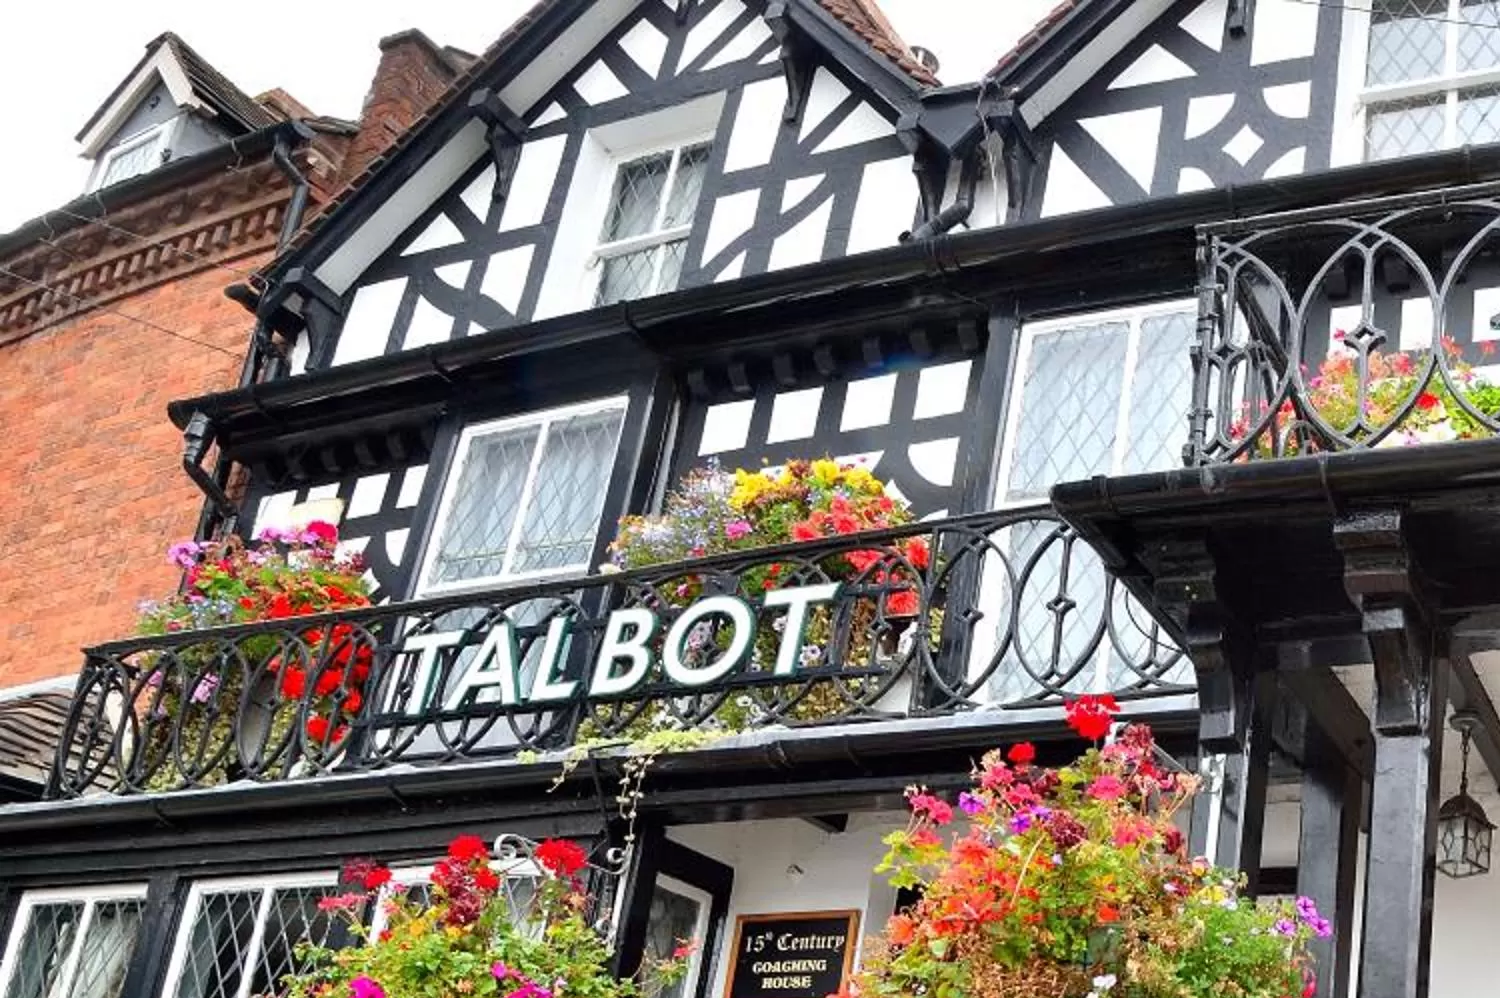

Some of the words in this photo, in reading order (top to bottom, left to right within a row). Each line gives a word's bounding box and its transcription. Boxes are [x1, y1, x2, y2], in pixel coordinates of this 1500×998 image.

[403, 582, 842, 715] TALBOT
[777, 932, 845, 953] Century
[752, 959, 828, 974] COACHING
[761, 975, 812, 990] HOUSE
